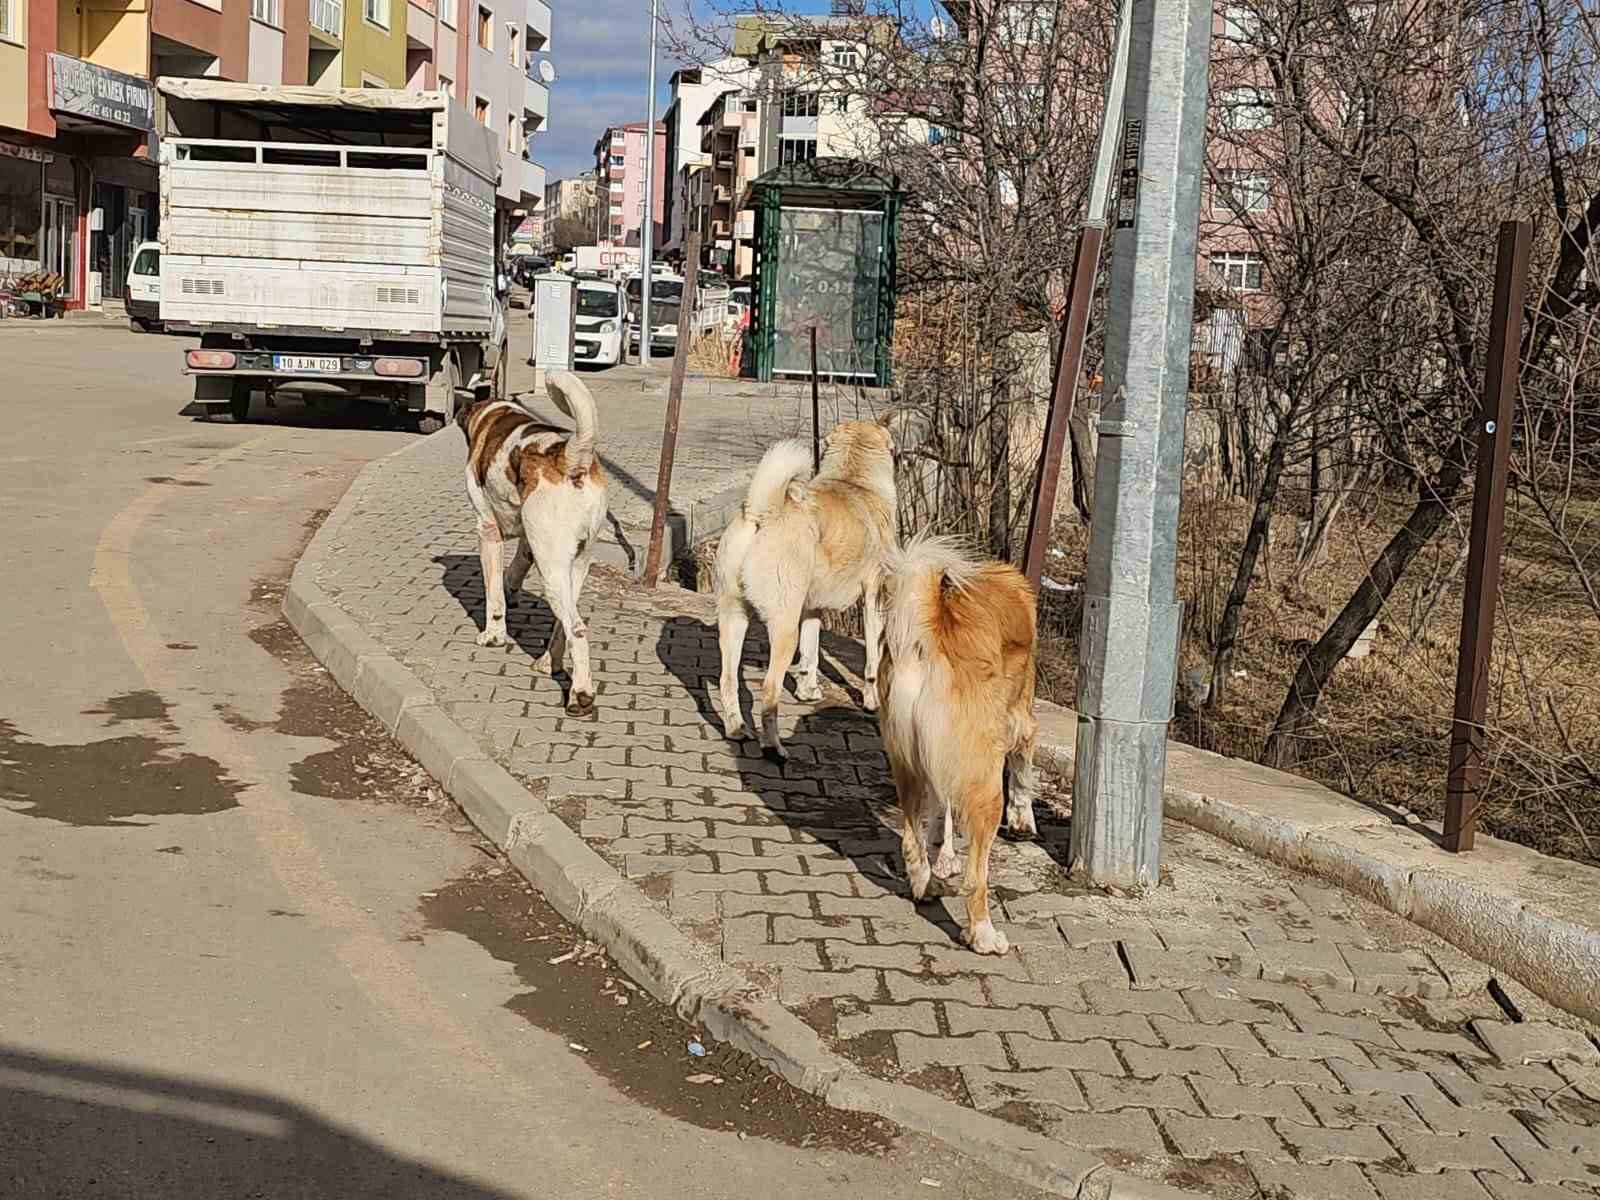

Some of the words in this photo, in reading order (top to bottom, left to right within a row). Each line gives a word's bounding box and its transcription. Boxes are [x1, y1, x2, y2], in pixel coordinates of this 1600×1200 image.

[98, 77, 125, 103] EKMEK
[281, 358, 293, 369] 10
[297, 359, 316, 370] AJN
[319, 359, 338, 370] 029
